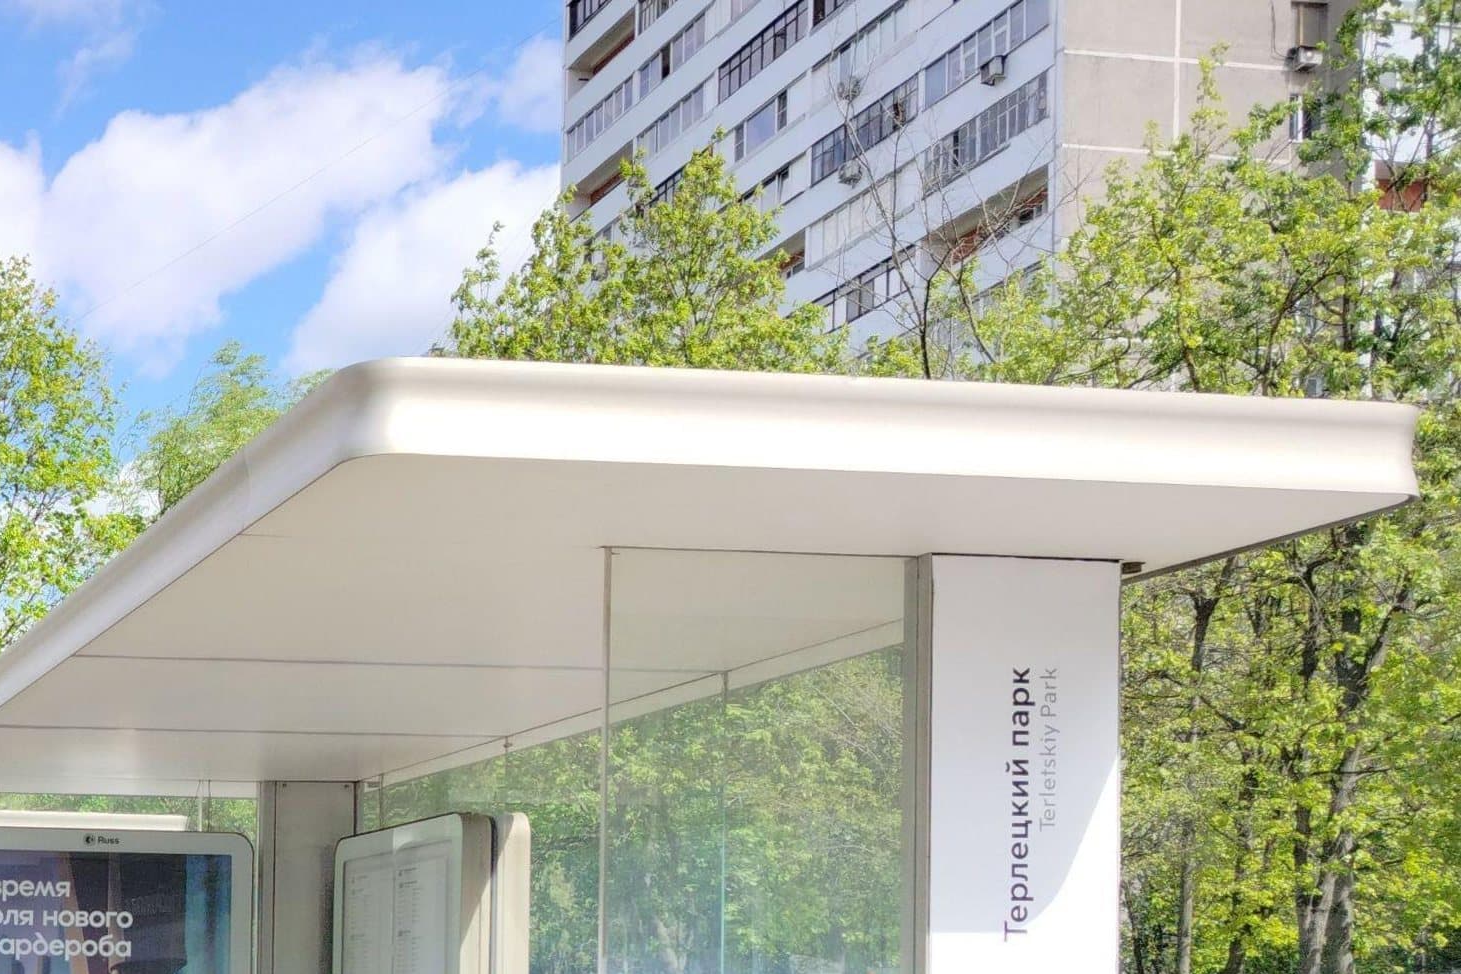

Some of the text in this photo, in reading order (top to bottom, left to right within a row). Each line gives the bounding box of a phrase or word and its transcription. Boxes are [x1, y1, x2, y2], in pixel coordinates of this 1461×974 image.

[1039, 667, 1060, 832] Terletskiy Park
[97, 835, 120, 845] Russ
[1004, 667, 1036, 942] Терлецкий парк
[42, 910, 134, 928] нового
